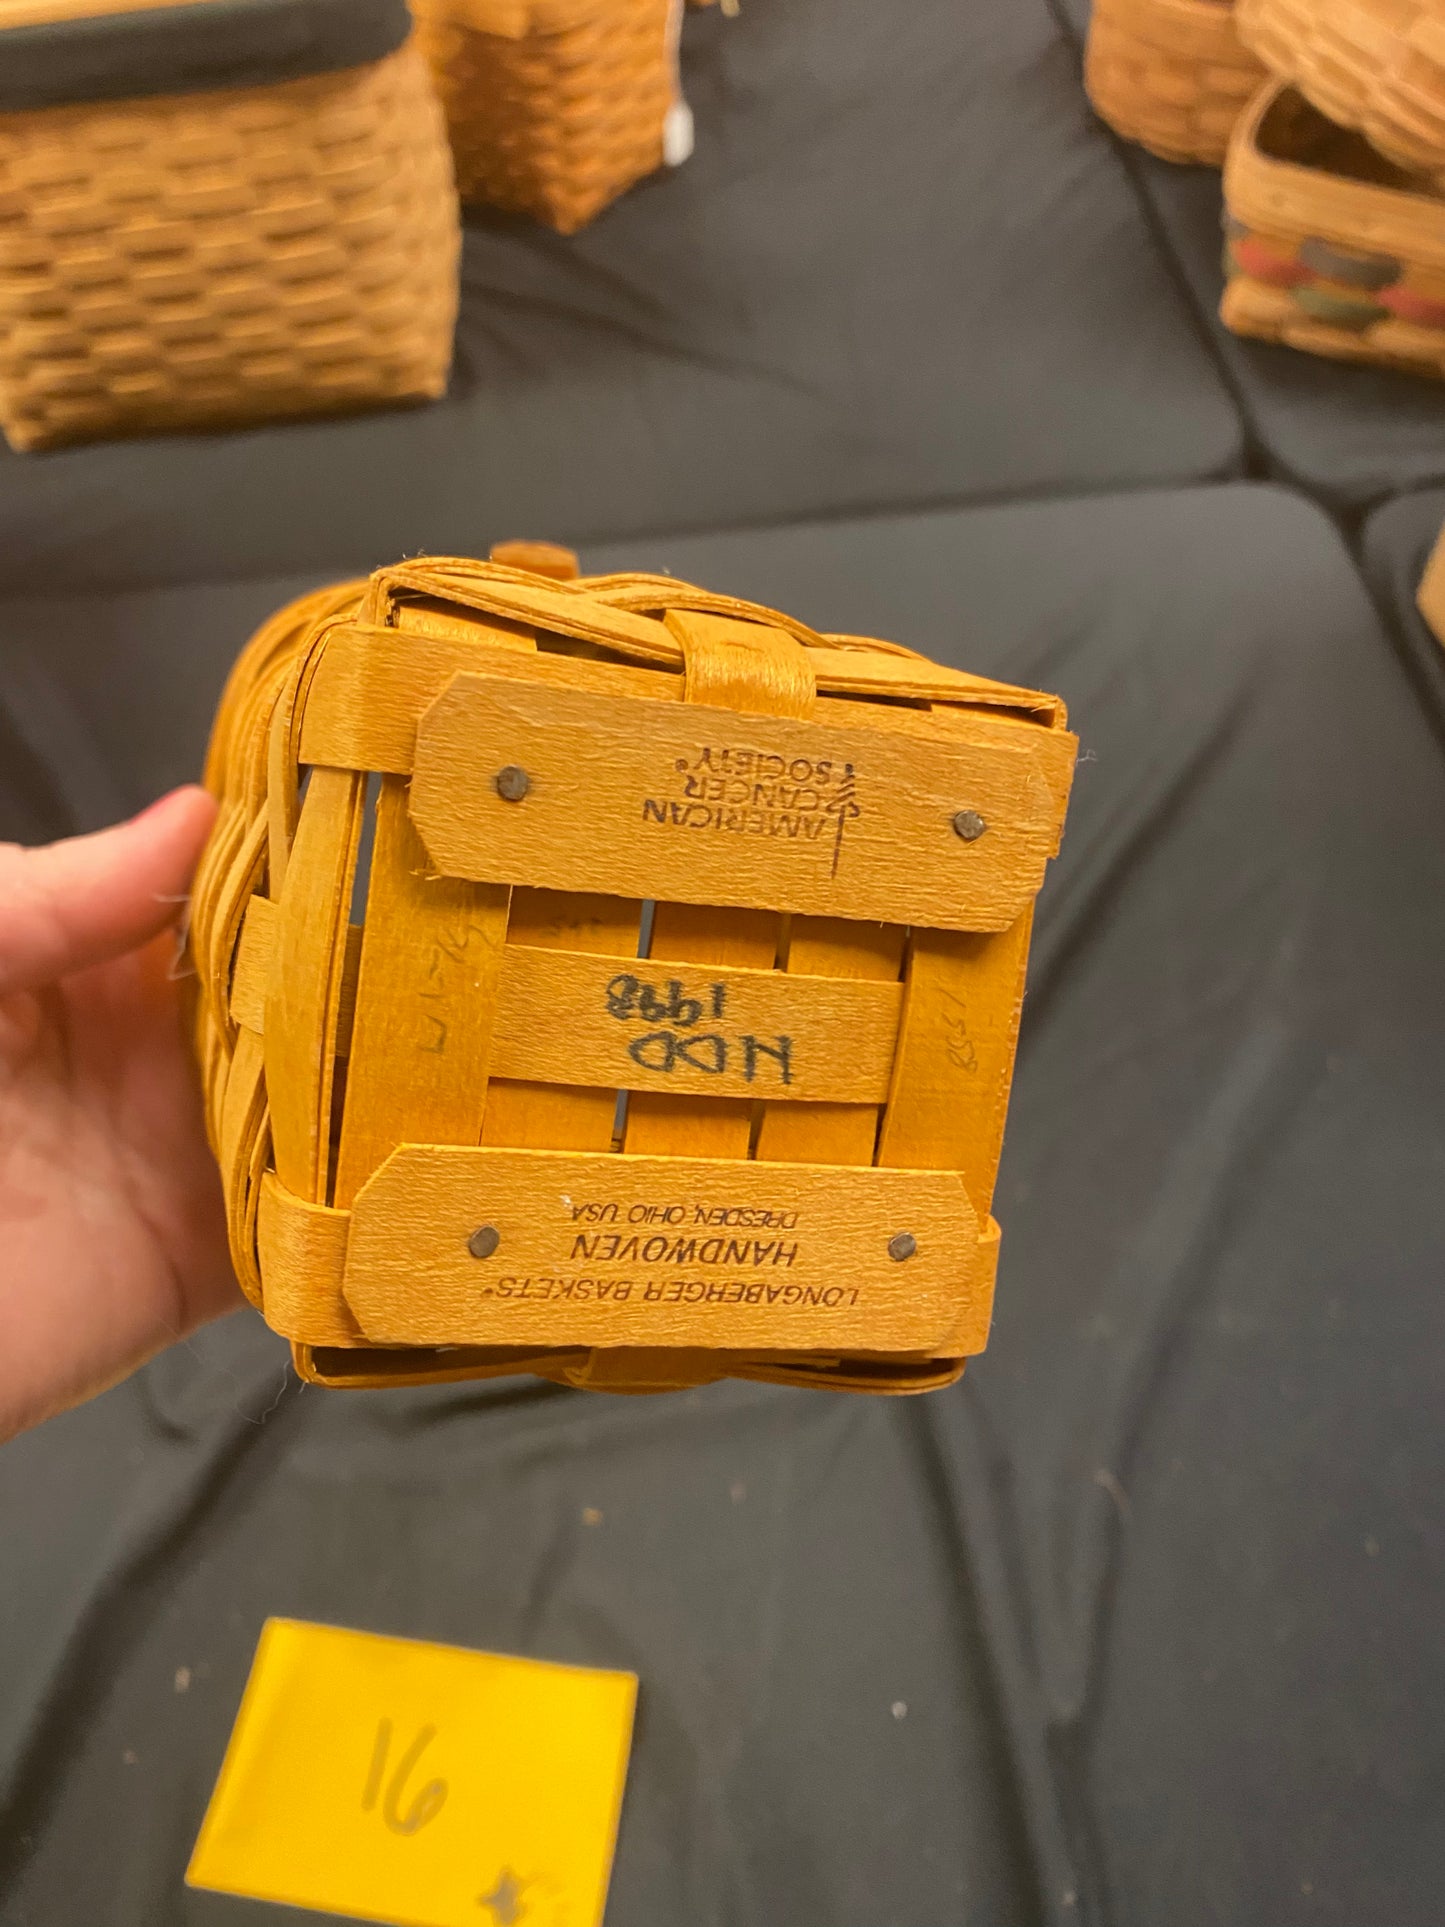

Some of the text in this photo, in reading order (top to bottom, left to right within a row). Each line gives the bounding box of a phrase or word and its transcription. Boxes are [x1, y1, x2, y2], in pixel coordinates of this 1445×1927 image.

[684, 775, 820, 811] CANCER
[642, 799, 826, 839] AMERICAN
[606, 974, 726, 1026] 1998
[571, 1203, 798, 1229] DRESDEN, OHIO USA
[570, 1234, 798, 1267] HANDWOVEN
[643, 1281, 859, 1307] LONGABERGER
[360, 1716, 449, 1836] 16
